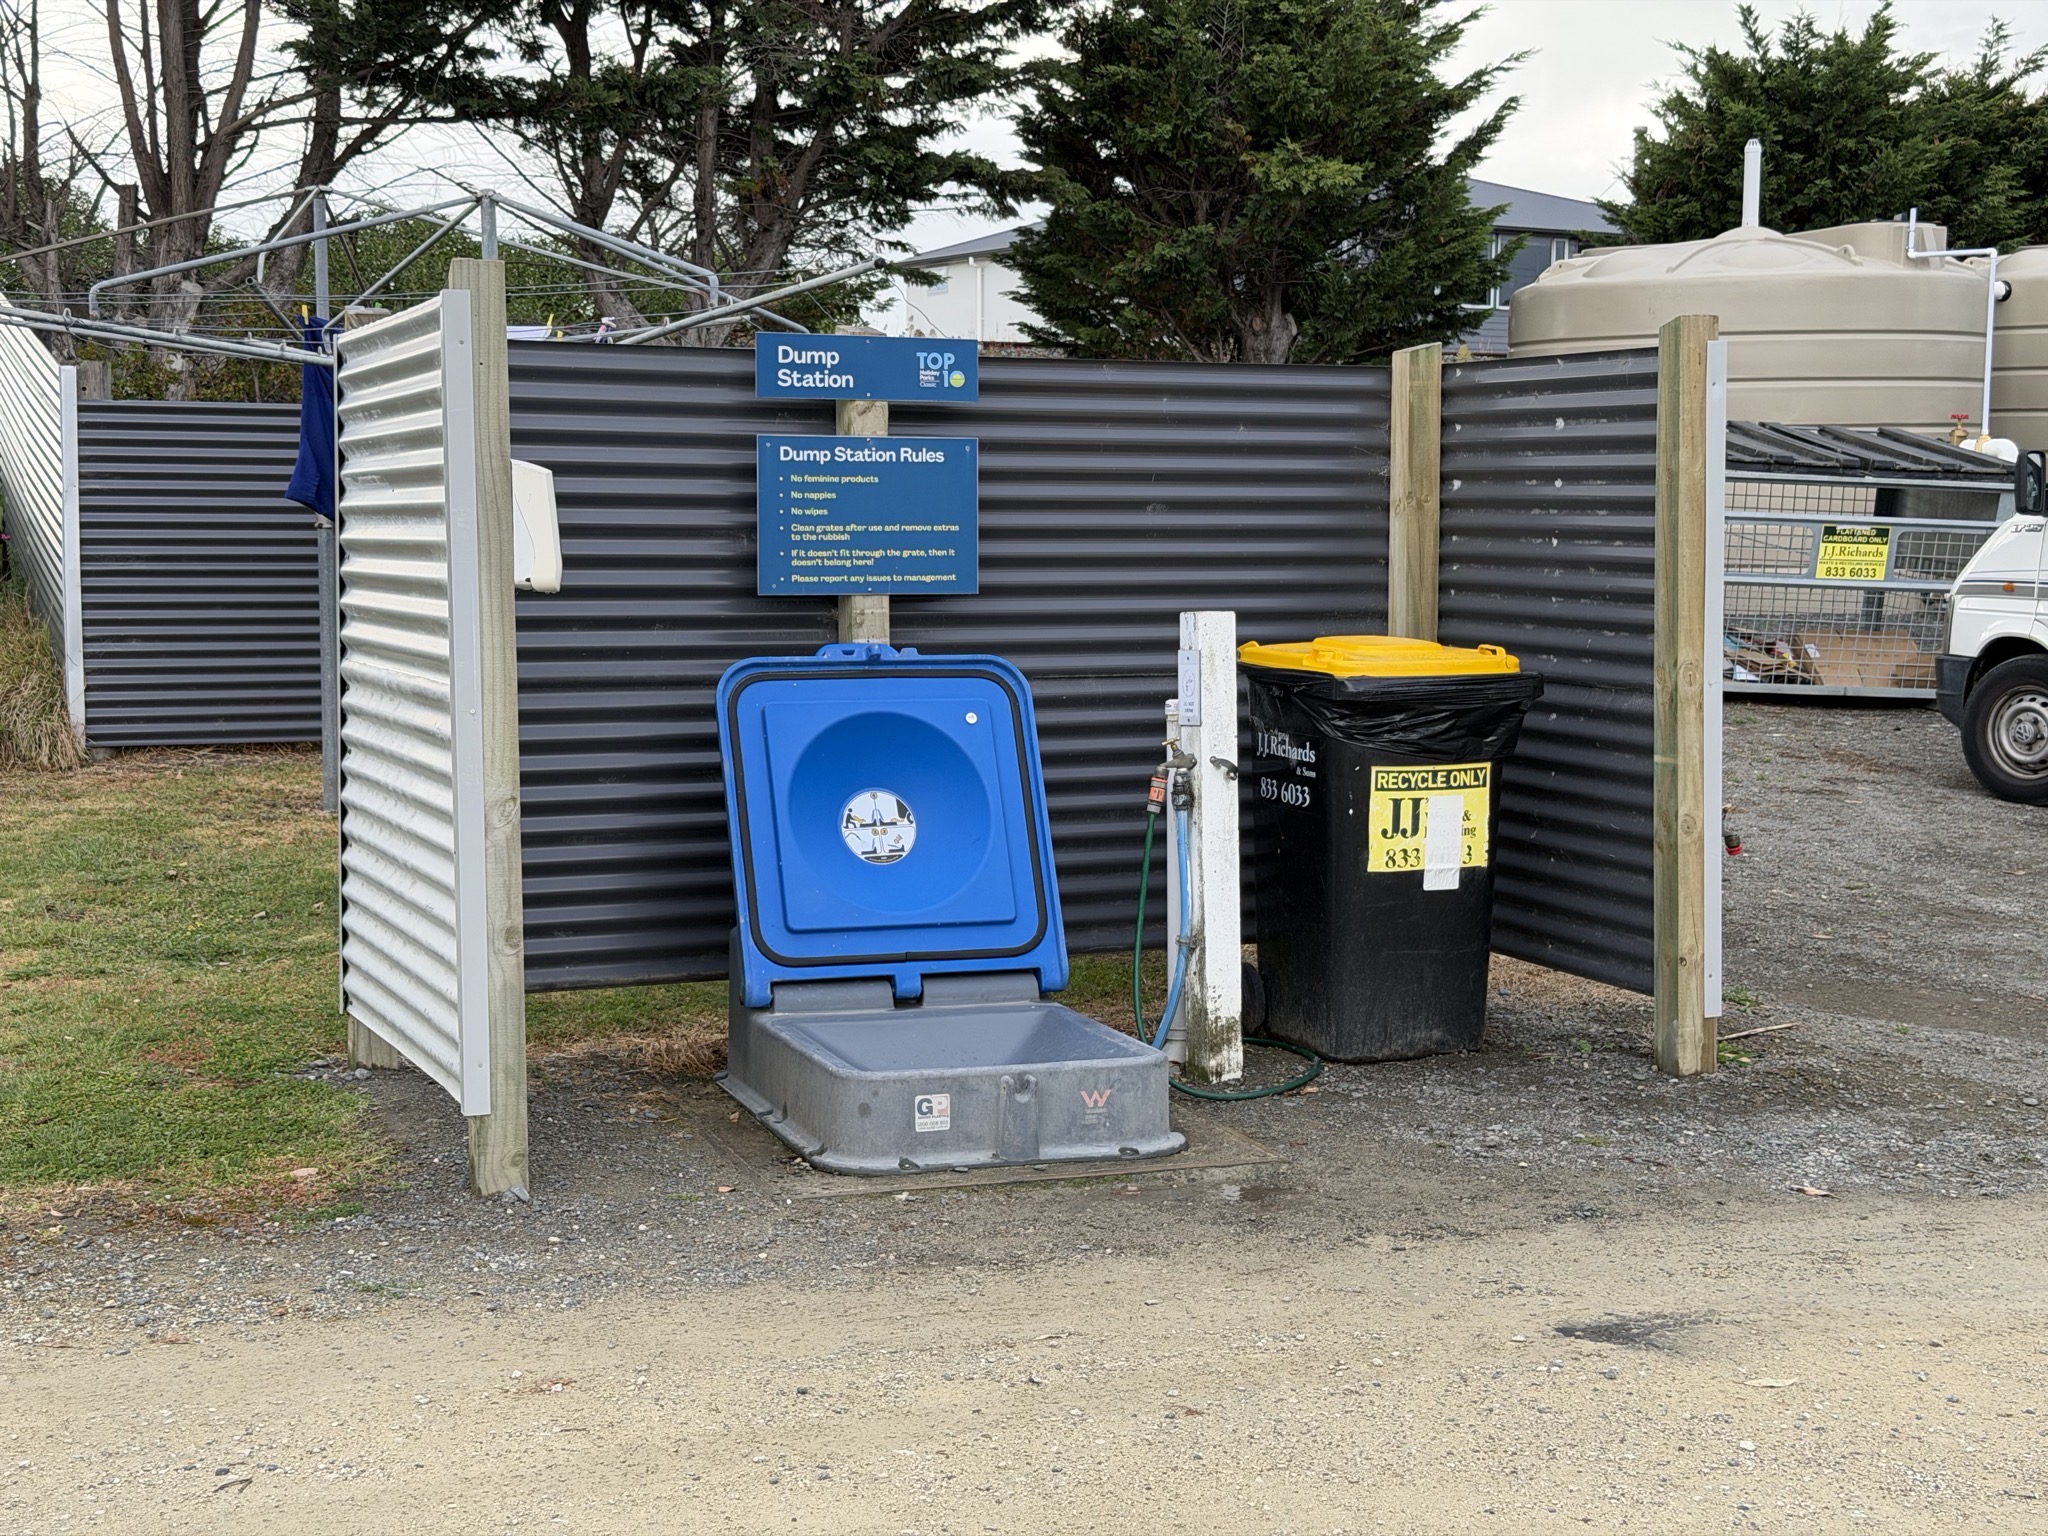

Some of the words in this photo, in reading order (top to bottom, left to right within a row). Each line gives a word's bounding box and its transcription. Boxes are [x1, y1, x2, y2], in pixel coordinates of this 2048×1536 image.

[777, 345, 840, 368] Dump
[916, 352, 955, 370] TOP
[777, 368, 854, 388] Station
[942, 370, 965, 388] 10
[779, 446, 831, 465] Dump
[834, 446, 896, 462] Station
[900, 447, 945, 463] Rules
[790, 474, 802, 482] No
[804, 474, 839, 483] feminine
[841, 475, 879, 484] products
[790, 491, 803, 499] No
[804, 491, 837, 500] nappies
[791, 507, 803, 515] No
[804, 507, 828, 516] wipes
[791, 523, 815, 532] Clean
[816, 524, 844, 533] grates
[845, 523, 867, 532] after
[884, 523, 900, 532] and
[933, 524, 959, 532] extras
[1836, 528, 1877, 536] FLATTENED
[791, 533, 801, 541] to
[802, 533, 817, 541] the
[818, 533, 851, 541] rubbish
[1823, 535, 1868, 543] CARDBOARD
[791, 549, 798, 557] If
[799, 549, 806, 557] it
[807, 549, 838, 557] doesn't
[840, 549, 851, 557] fit
[852, 549, 886, 558] through
[886, 549, 901, 557] the
[902, 549, 927, 558] grate,
[928, 548, 948, 556] then
[948, 548, 956, 556] it
[1821, 545, 1884, 559] J.J.Richards
[791, 558, 822, 566] doesn't
[824, 558, 852, 568] belong
[853, 558, 874, 566] here!
[1825, 566, 1846, 577] 833
[1849, 567, 1877, 578] 6033
[791, 574, 819, 583] Please
[820, 574, 849, 583] report
[850, 575, 865, 583] any
[866, 574, 892, 582] issues
[893, 574, 902, 582] to
[903, 574, 957, 583] management
[1256, 732, 1316, 763] J.J.Richards
[1296, 766, 1302, 776] &
[1302, 766, 1317, 778] Sons
[1376, 771, 1448, 789] RECYCLE
[1450, 768, 1487, 787] ONLY
[1260, 776, 1278, 800] 833
[1280, 782, 1311, 807] 6033
[1462, 809, 1472, 822] &
[1385, 848, 1421, 869] 833
